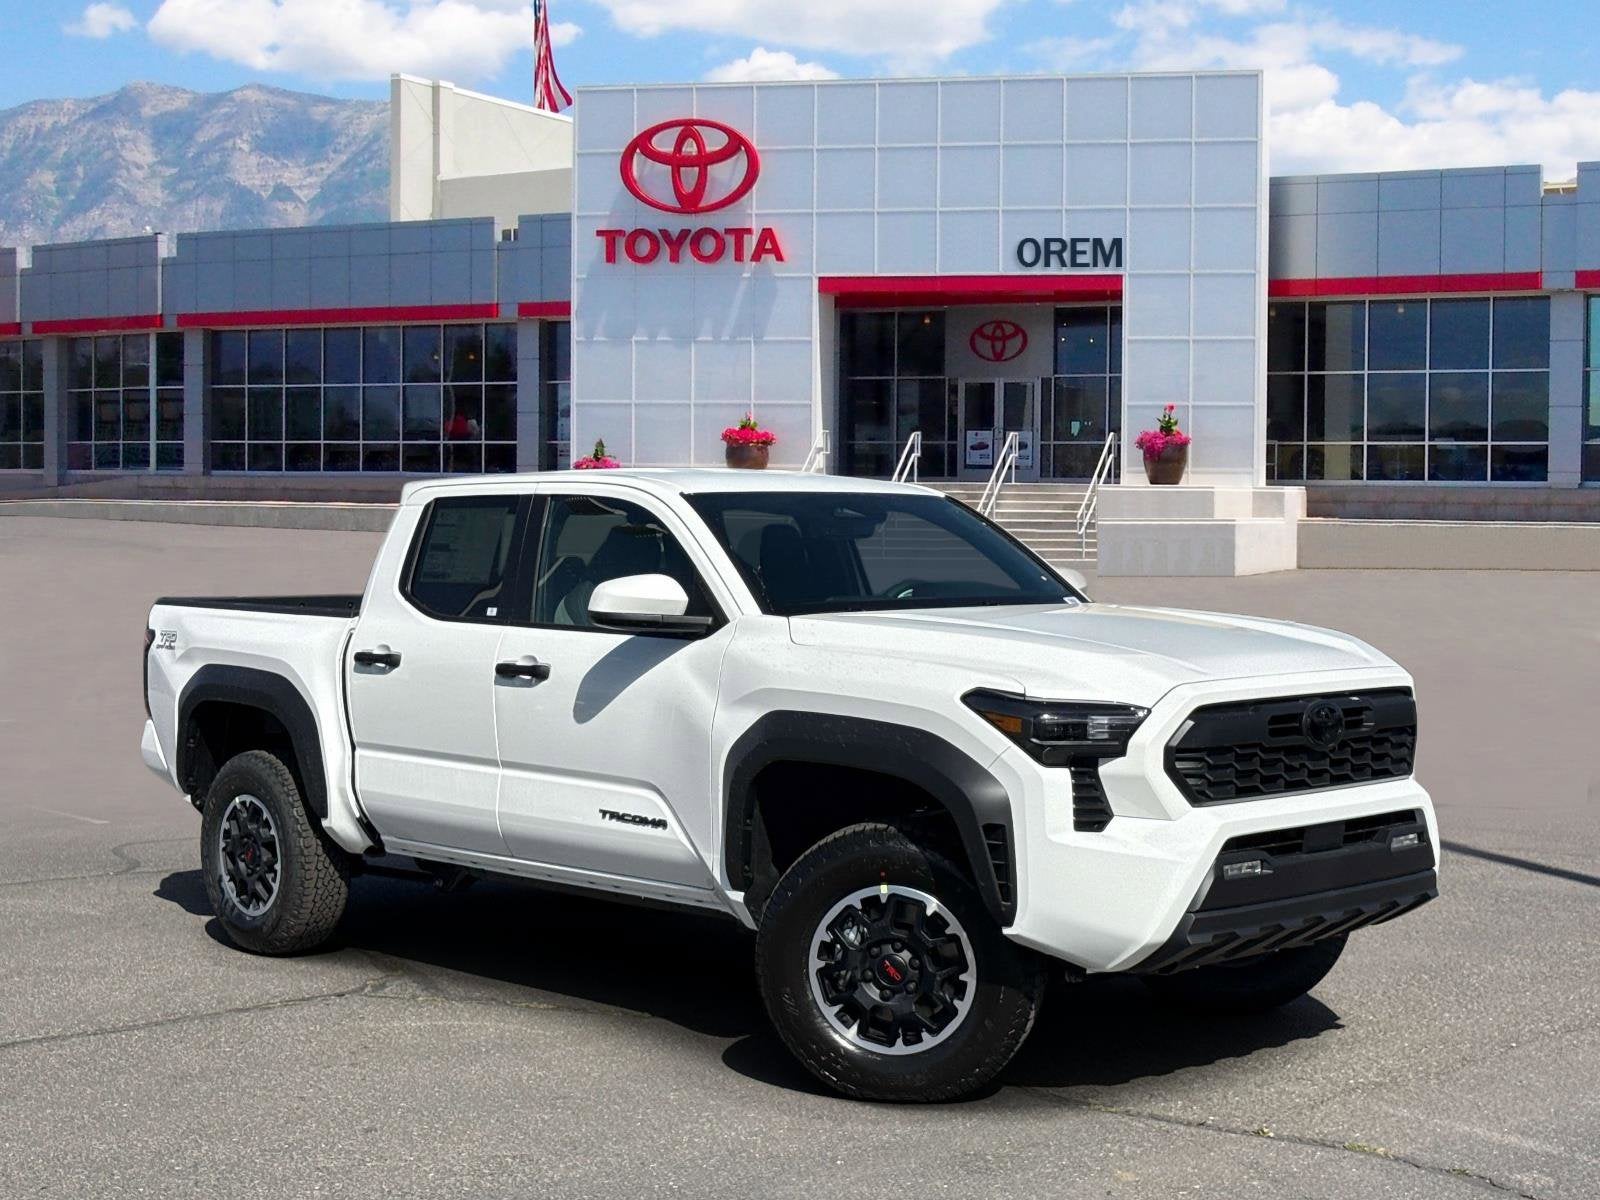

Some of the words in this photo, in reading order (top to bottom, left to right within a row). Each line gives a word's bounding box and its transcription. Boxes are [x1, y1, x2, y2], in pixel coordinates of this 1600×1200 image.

[596, 227, 784, 264] TOYOTA
[1017, 237, 1122, 268] OREM
[599, 808, 668, 830] TACOMA
